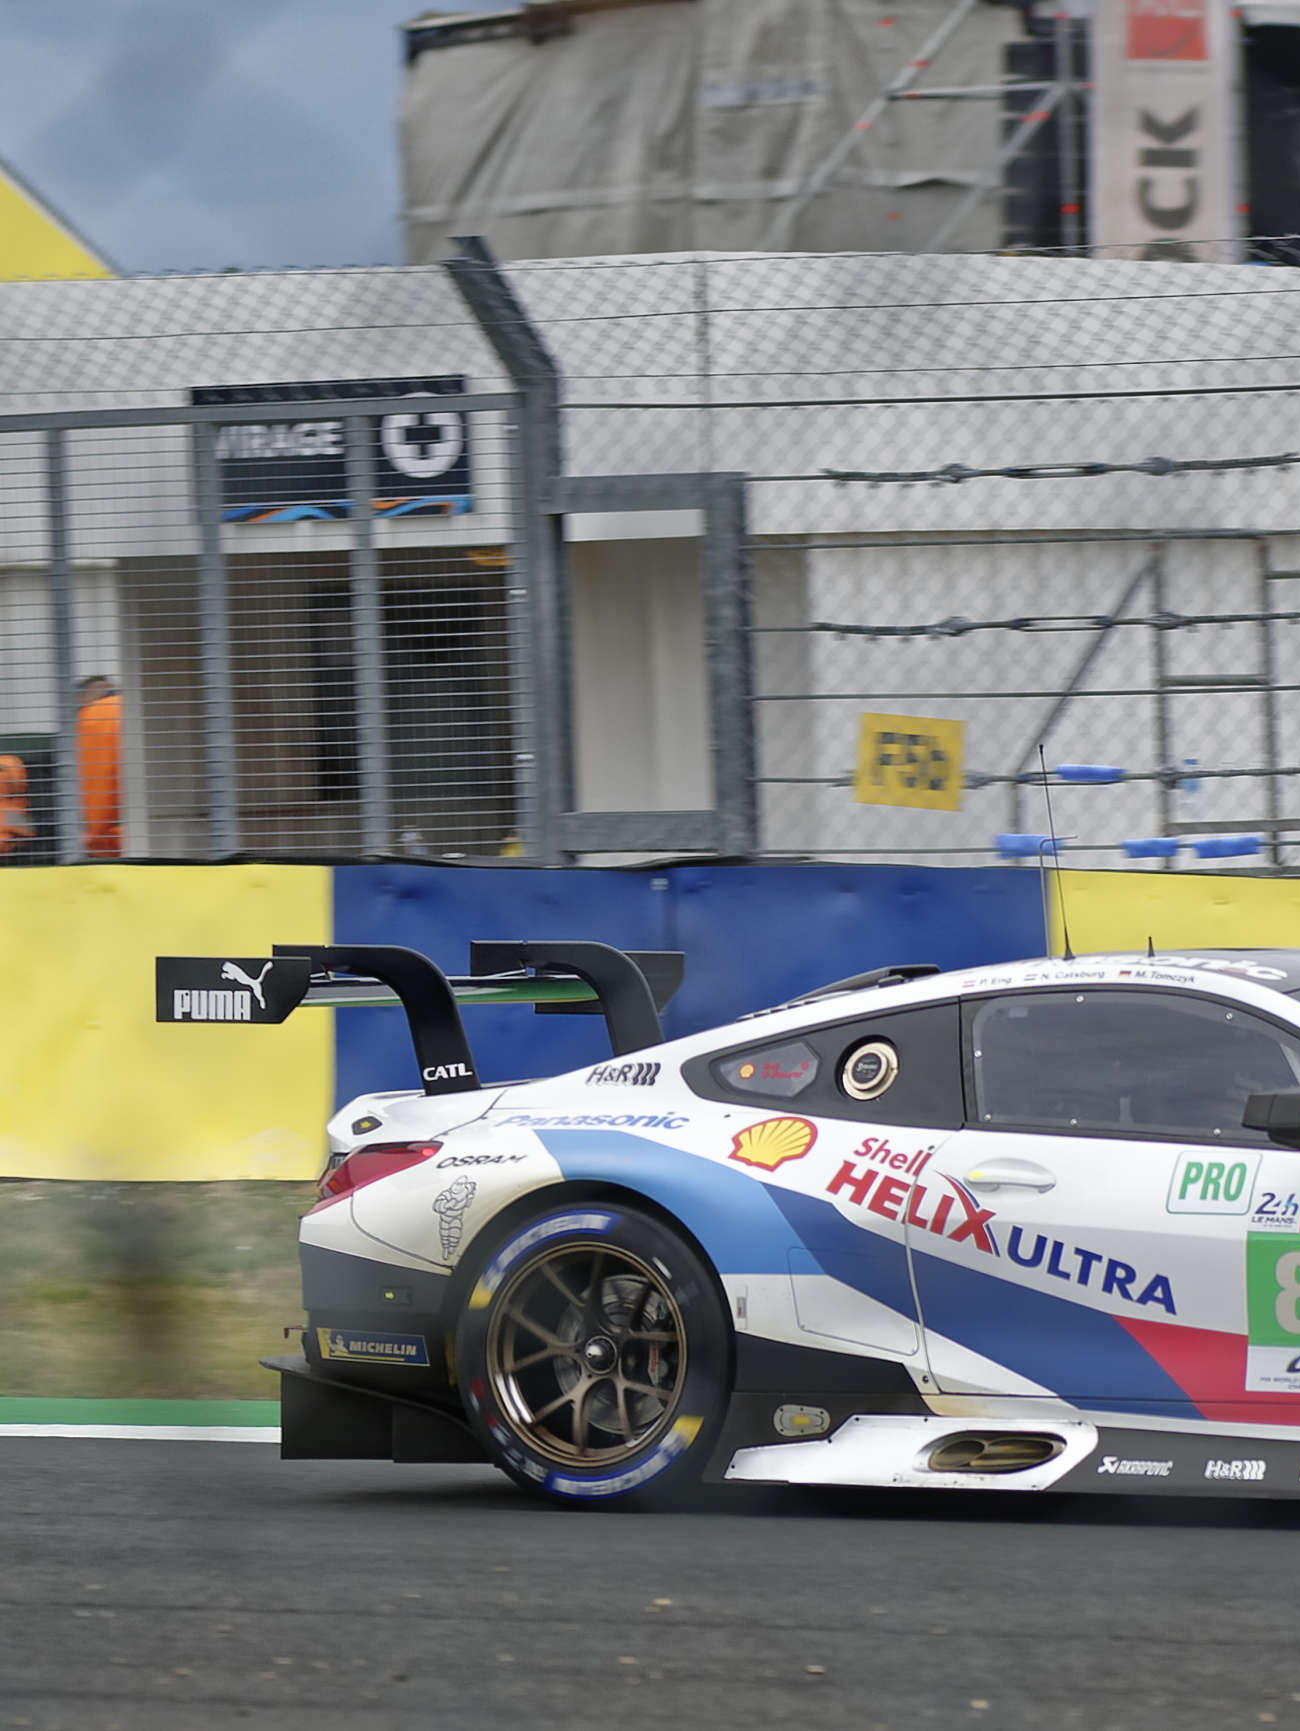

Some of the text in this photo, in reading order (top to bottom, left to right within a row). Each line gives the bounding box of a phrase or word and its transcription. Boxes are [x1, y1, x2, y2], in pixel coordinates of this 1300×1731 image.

[173, 989, 251, 1021] PUMA
[422, 1062, 473, 1082] CATL
[494, 1111, 690, 1130] Panasonic
[436, 1154, 528, 1170] OSRAM
[853, 1136, 933, 1176] Shell
[1178, 1161, 1248, 1201] PRO
[825, 1159, 1178, 1316] HELIX ULTRA
[349, 1340, 417, 1356] MICHELIN
